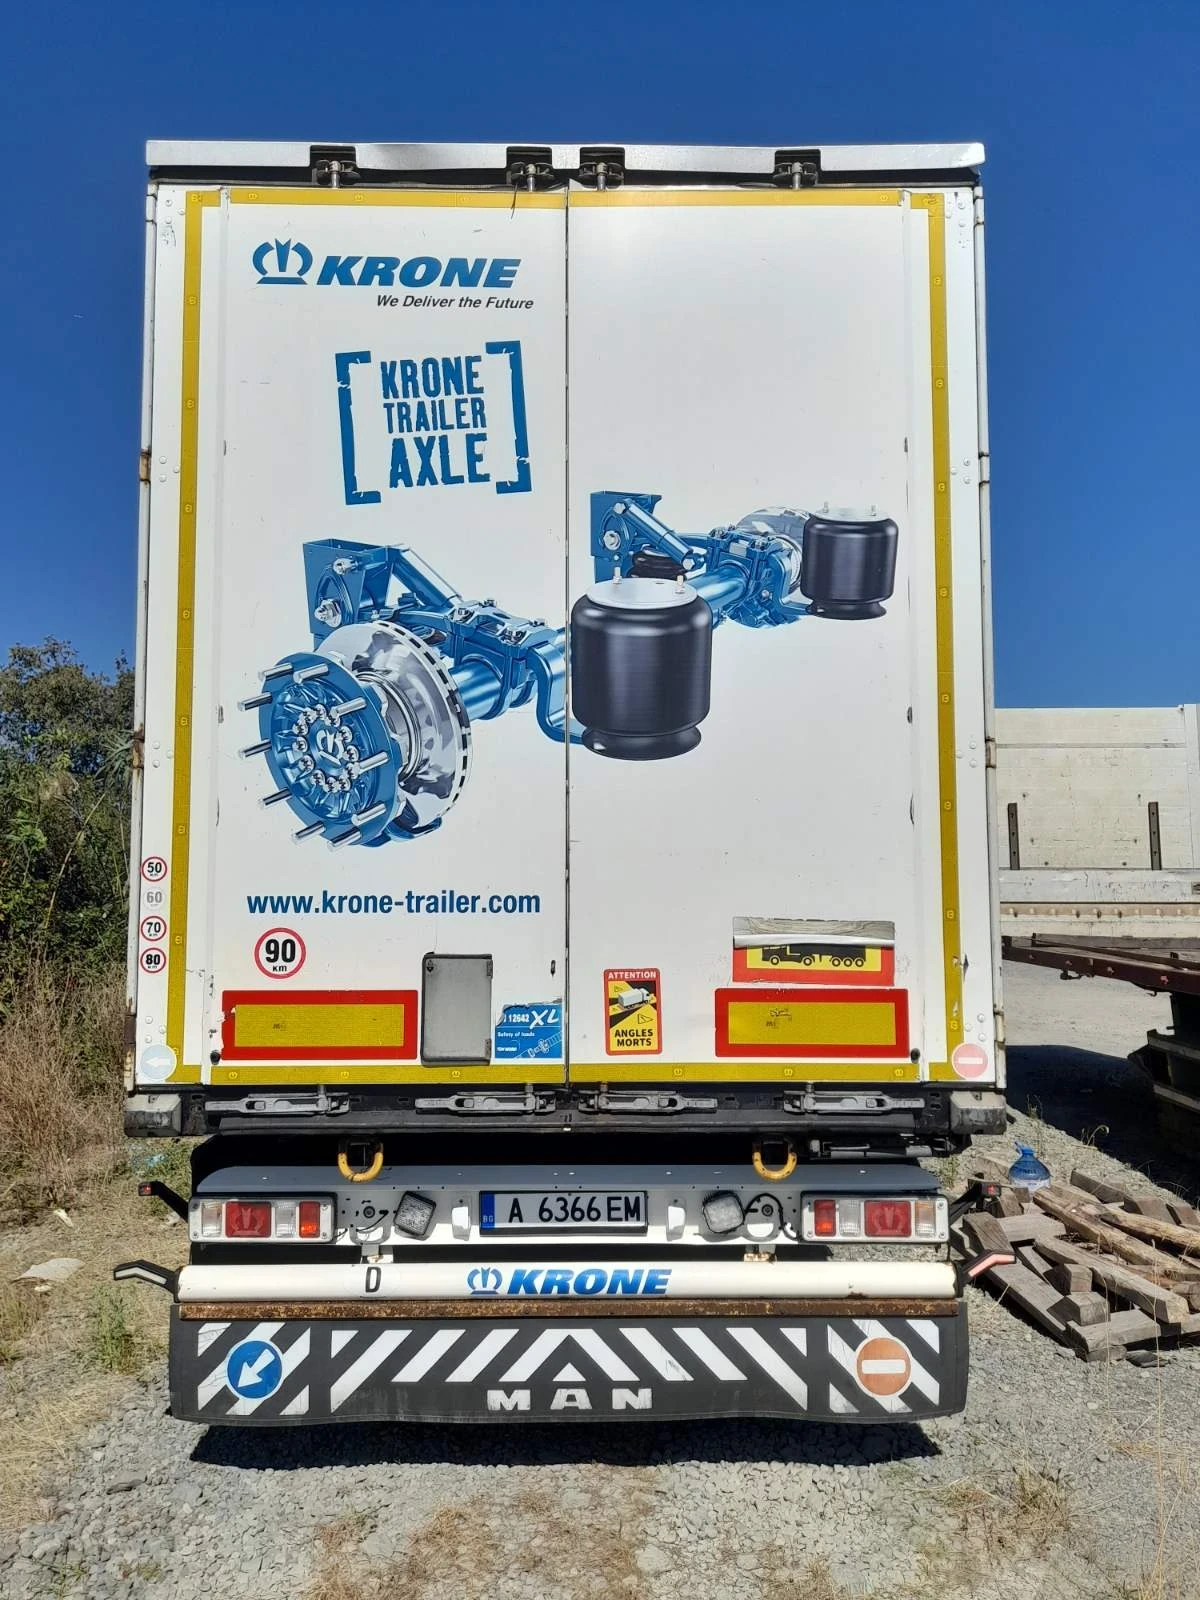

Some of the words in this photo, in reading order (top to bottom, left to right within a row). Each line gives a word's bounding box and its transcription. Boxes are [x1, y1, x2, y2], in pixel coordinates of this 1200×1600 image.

[316, 255, 522, 288] KRONE
[376, 295, 399, 308] We
[402, 295, 454, 308] Deliver
[458, 296, 482, 309] the
[485, 296, 535, 309] Future
[380, 355, 485, 400] KRONE
[382, 397, 487, 434] TRAILER
[389, 432, 491, 488] AXLE
[147, 862, 162, 873] 50
[146, 891, 162, 903] 60
[247, 890, 541, 914] www.krone-trailer.com
[146, 922, 161, 933] 70
[145, 954, 161, 965] 80
[264, 938, 296, 963] 90
[608, 971, 656, 979] ATTENTION
[529, 1008, 560, 1030] XL
[614, 1028, 653, 1038] ANGLES
[617, 1038, 652, 1047] MORTS
[482, 1215, 494, 1223] BG
[508, 1197, 524, 1224] A
[538, 1196, 601, 1223] 6366
[606, 1195, 641, 1222] EM
[364, 1266, 382, 1293] D
[507, 1268, 673, 1295] KRONE
[486, 1388, 653, 1411] MAN
